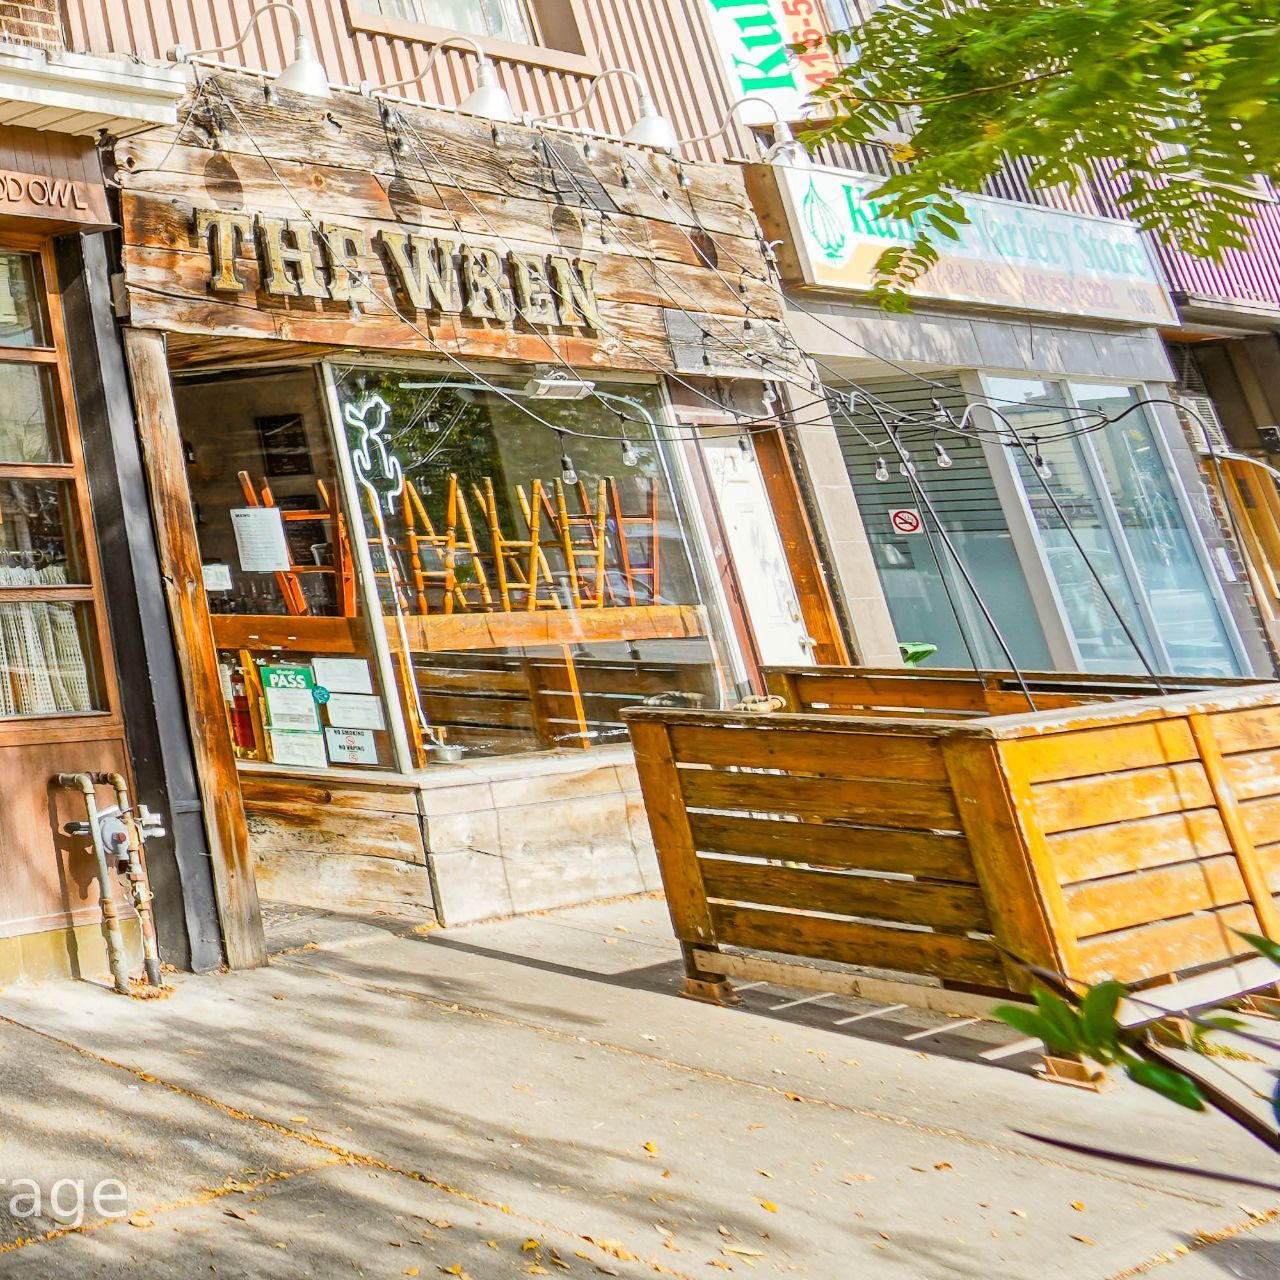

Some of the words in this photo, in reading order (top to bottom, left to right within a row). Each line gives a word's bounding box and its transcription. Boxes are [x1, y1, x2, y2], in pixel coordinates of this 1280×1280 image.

[27, 178, 89, 209] OWL
[972, 205, 1076, 280] Variety
[1074, 223, 1148, 277] Store
[196, 207, 374, 304] THE
[381, 228, 610, 332] WREN
[269, 673, 308, 689] PASS
